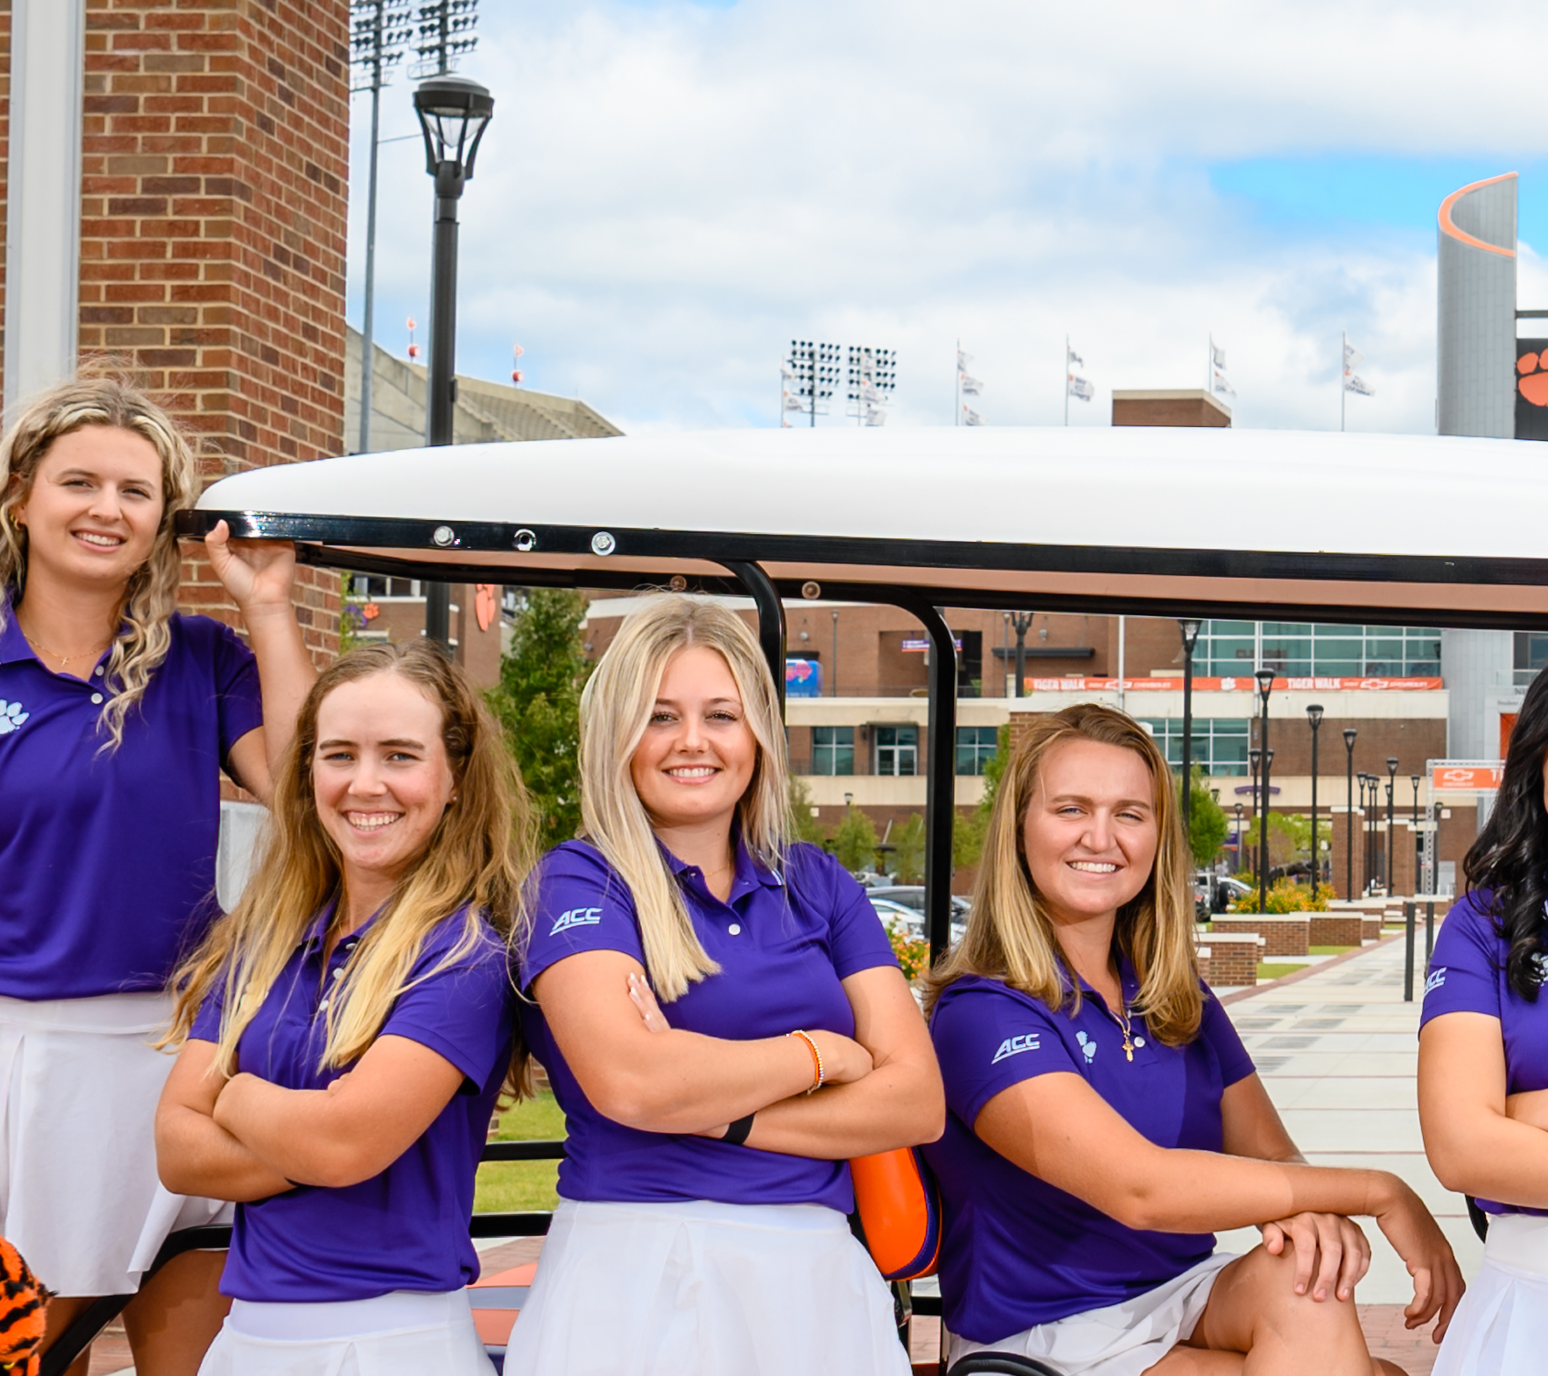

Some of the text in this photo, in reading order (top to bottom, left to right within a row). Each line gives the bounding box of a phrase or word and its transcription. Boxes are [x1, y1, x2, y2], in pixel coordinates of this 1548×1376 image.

[1033, 679, 1059, 690] TIGER
[1060, 679, 1086, 690] WALK
[1287, 678, 1313, 690] TIGER
[1314, 678, 1341, 689] WALK
[551, 907, 603, 932] ACC
[994, 1033, 1041, 1060] ACC
